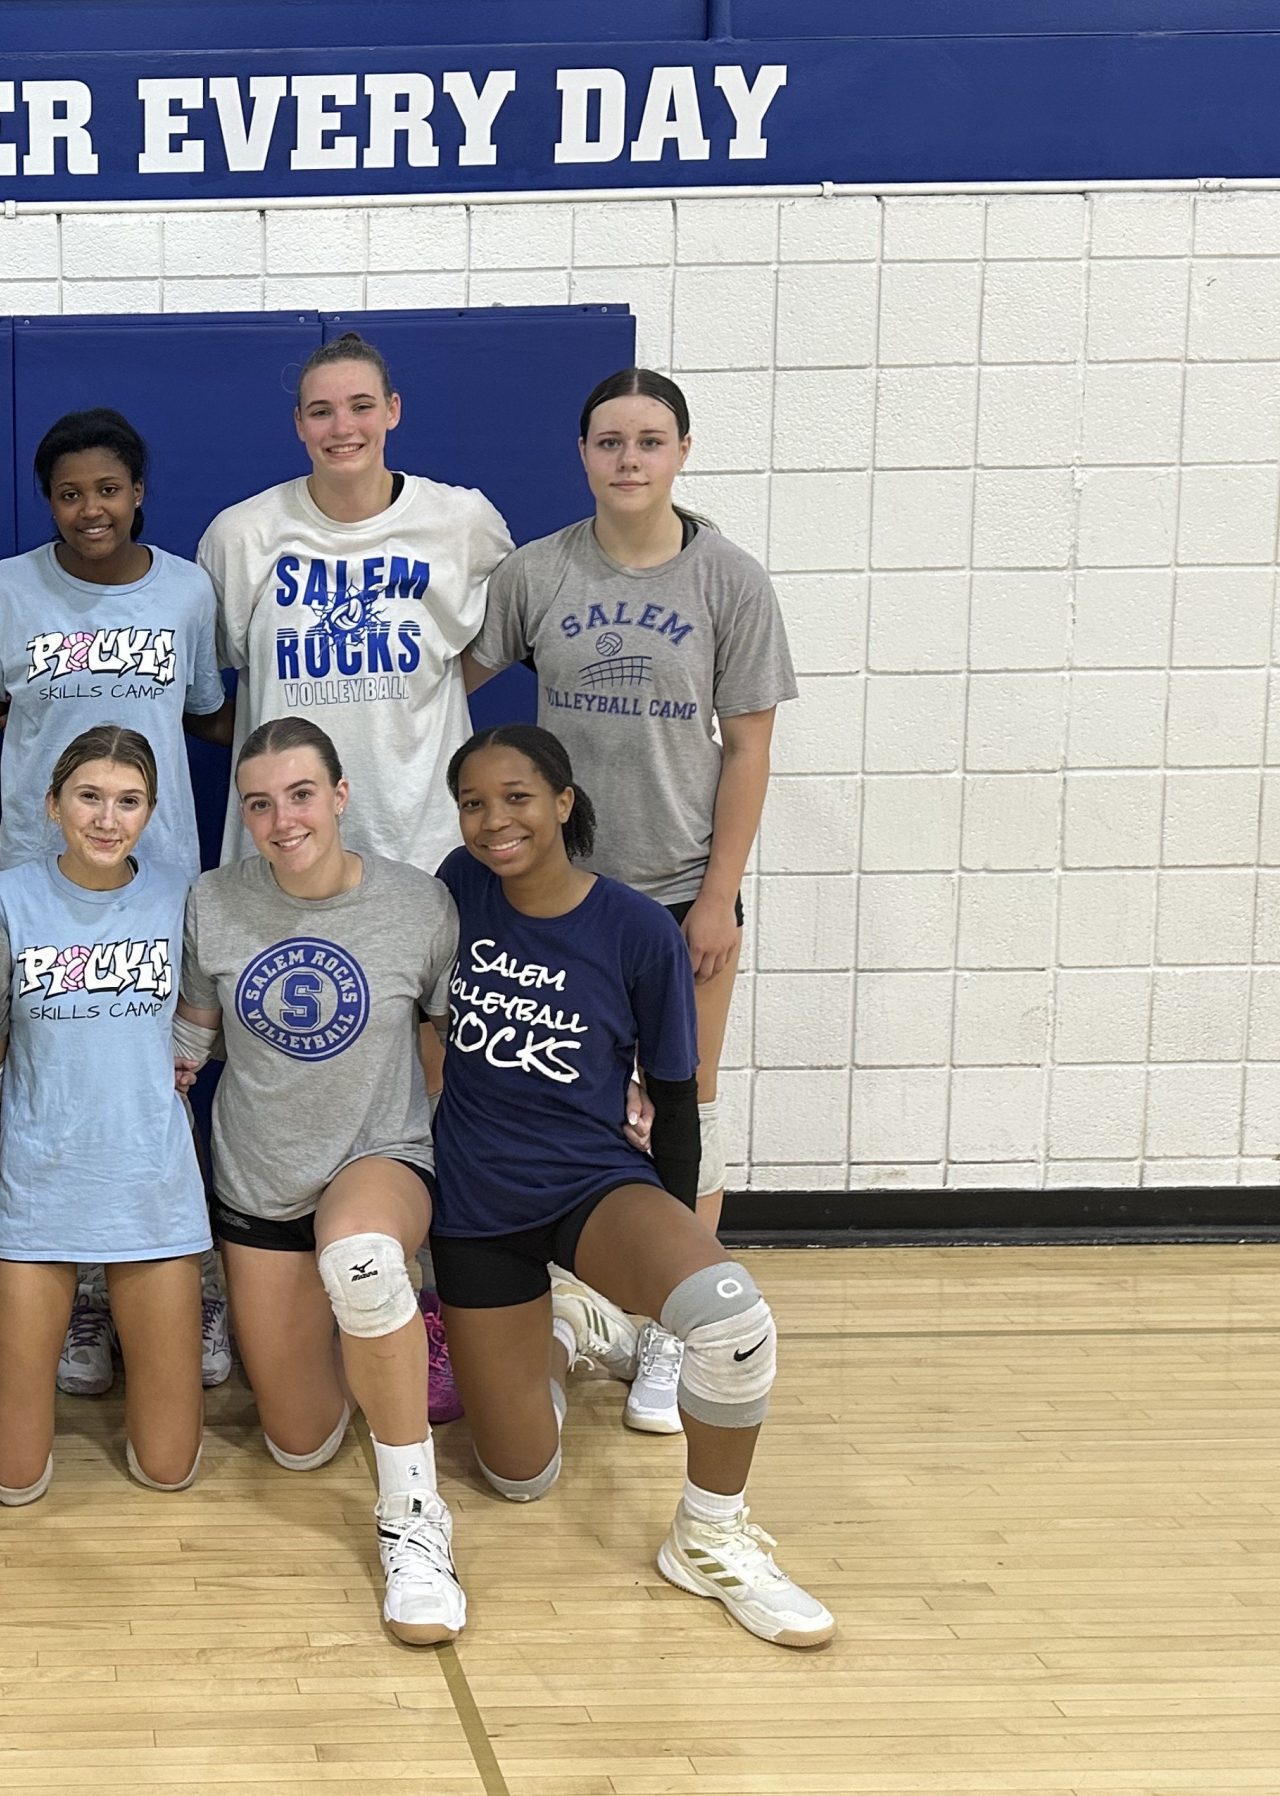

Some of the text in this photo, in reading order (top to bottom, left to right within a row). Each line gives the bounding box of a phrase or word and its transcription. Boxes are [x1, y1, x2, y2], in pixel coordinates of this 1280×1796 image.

[138, 70, 516, 173] EVERY
[554, 65, 787, 164] DAY
[276, 555, 430, 607] SALEM
[276, 620, 421, 680] ROCKS
[560, 602, 694, 646] SALEM
[26, 625, 177, 687] ROCKS
[39, 684, 165, 701] SKILLS CAMP
[284, 676, 409, 707] VOLLEYBALL
[545, 687, 697, 721] VLLEYBALL CAMP
[17, 938, 172, 1001] ROCKS
[245, 949, 358, 1003] SALEM ROCKS
[471, 939, 566, 991] SALEM
[29, 1001, 162, 1020] SKILLS CAMP
[280, 971, 323, 1030] S
[247, 1009, 355, 1050] VOLLEYBALL
